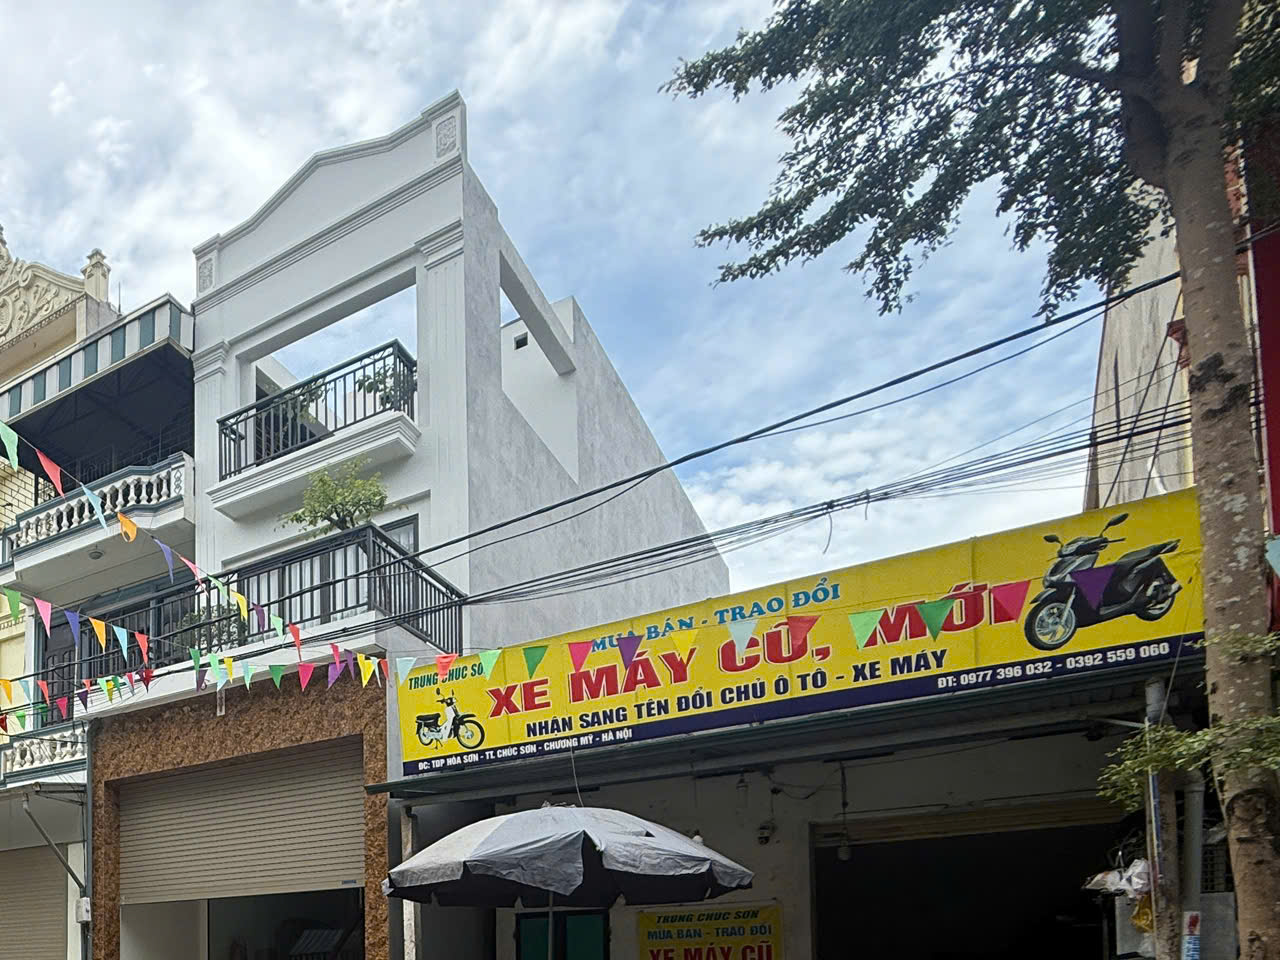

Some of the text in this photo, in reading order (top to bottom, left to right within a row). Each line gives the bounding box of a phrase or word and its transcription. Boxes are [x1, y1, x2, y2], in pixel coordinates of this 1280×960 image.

[646, 617, 694, 641] BÁN
[714, 597, 785, 625] TRAO
[792, 577, 840, 608] ĐỔI
[409, 672, 439, 690] TRUNG
[489, 679, 551, 718] XE
[569, 647, 696, 703] MÁY
[720, 621, 831, 672] CŨ,
[938, 677, 956, 689] ĐT:
[960, 670, 992, 685] 0977
[996, 665, 1022, 680] 396
[1026, 661, 1052, 675] 032
[1066, 655, 1103, 669] 0392
[1107, 648, 1135, 663] 559
[1140, 642, 1170, 657] 060
[526, 716, 573, 737] NHẬN
[579, 707, 627, 729] SANG
[634, 699, 670, 719] TÊN
[677, 686, 712, 712] ĐỔI
[720, 678, 765, 705] CHỦ
[774, 675, 789, 696] Ô
[797, 668, 827, 691] TÔ
[852, 661, 881, 682] XE
[890, 649, 947, 676] MÁY
[418, 761, 430, 771] ĐC:
[431, 759, 446, 769] TDP
[463, 753, 479, 764] SƠN
[519, 744, 537, 755] SƠN
[580, 734, 593, 746] MỸ
[602, 730, 614, 742] HÀ
[616, 727, 632, 741] NỘI
[648, 929, 672, 940] MUA
[715, 926, 745, 937] TRAO
[656, 913, 693, 923] TRUNG
